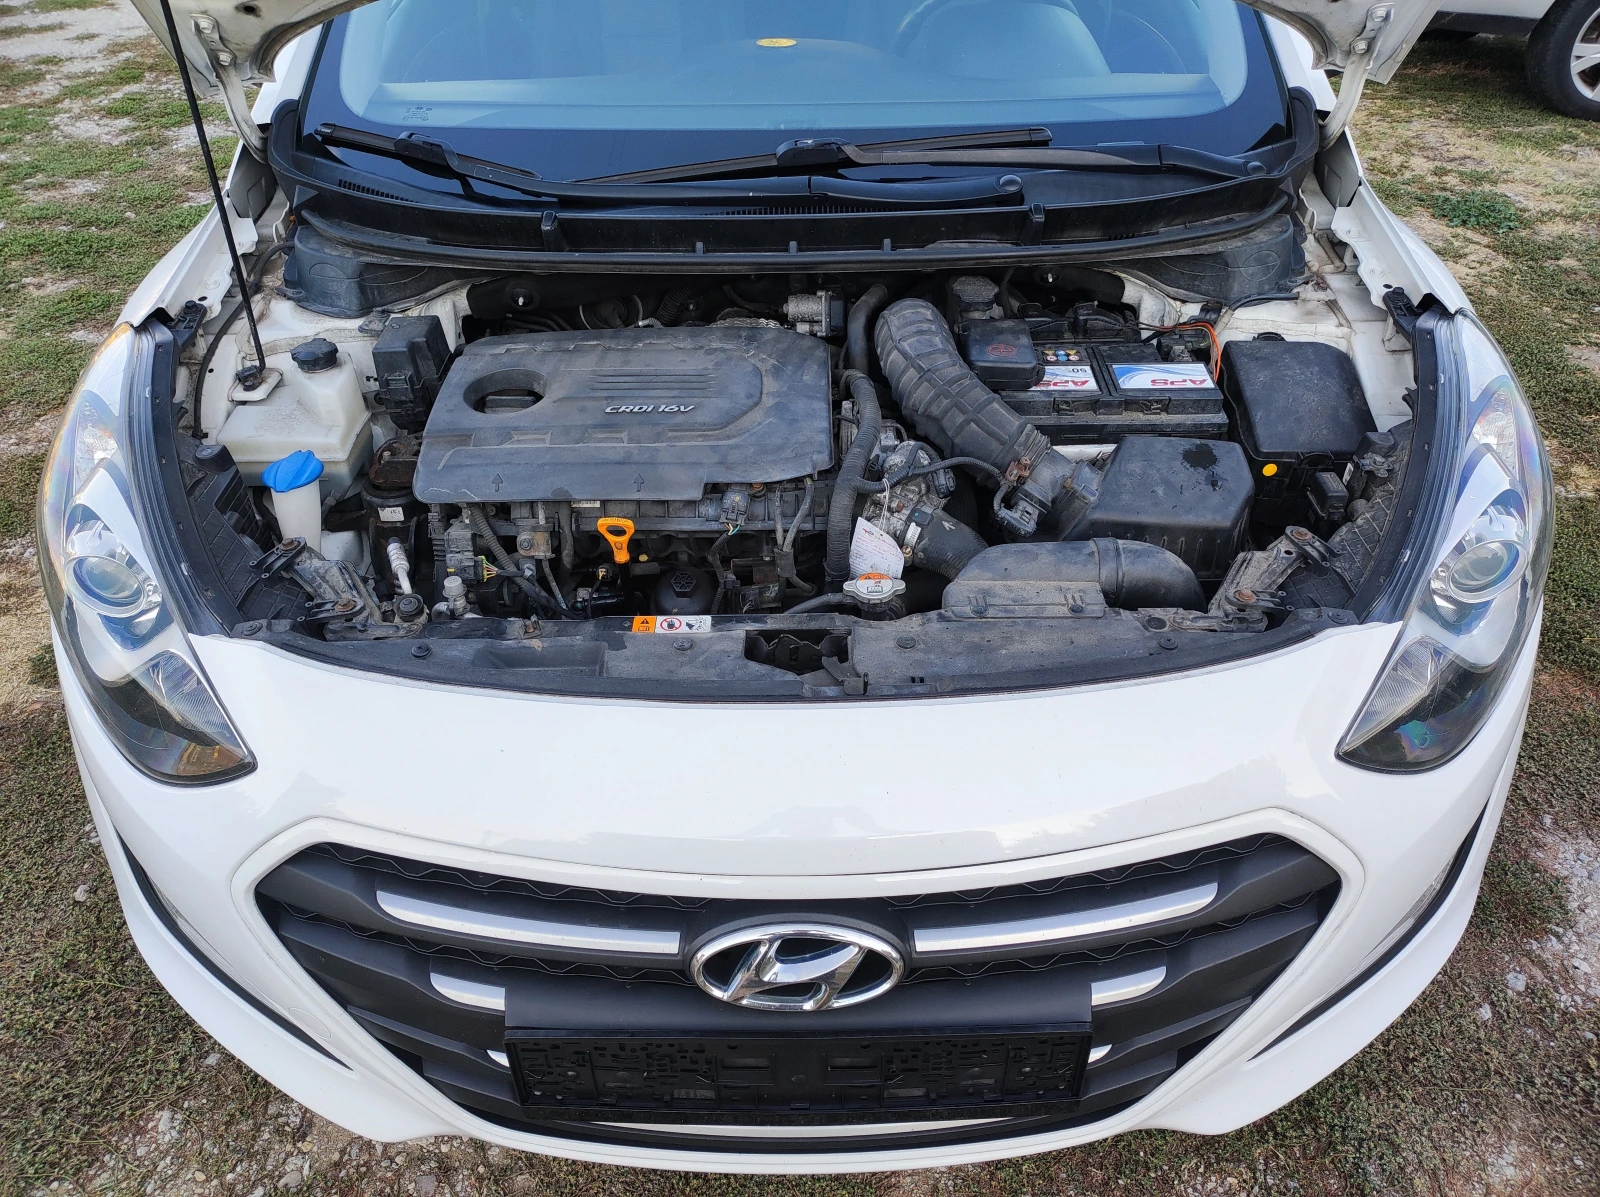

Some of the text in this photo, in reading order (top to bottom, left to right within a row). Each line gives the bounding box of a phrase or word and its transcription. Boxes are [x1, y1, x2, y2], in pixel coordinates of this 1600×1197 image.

[1150, 378, 1209, 388] APS
[604, 404, 696, 413] CRDI 16V
